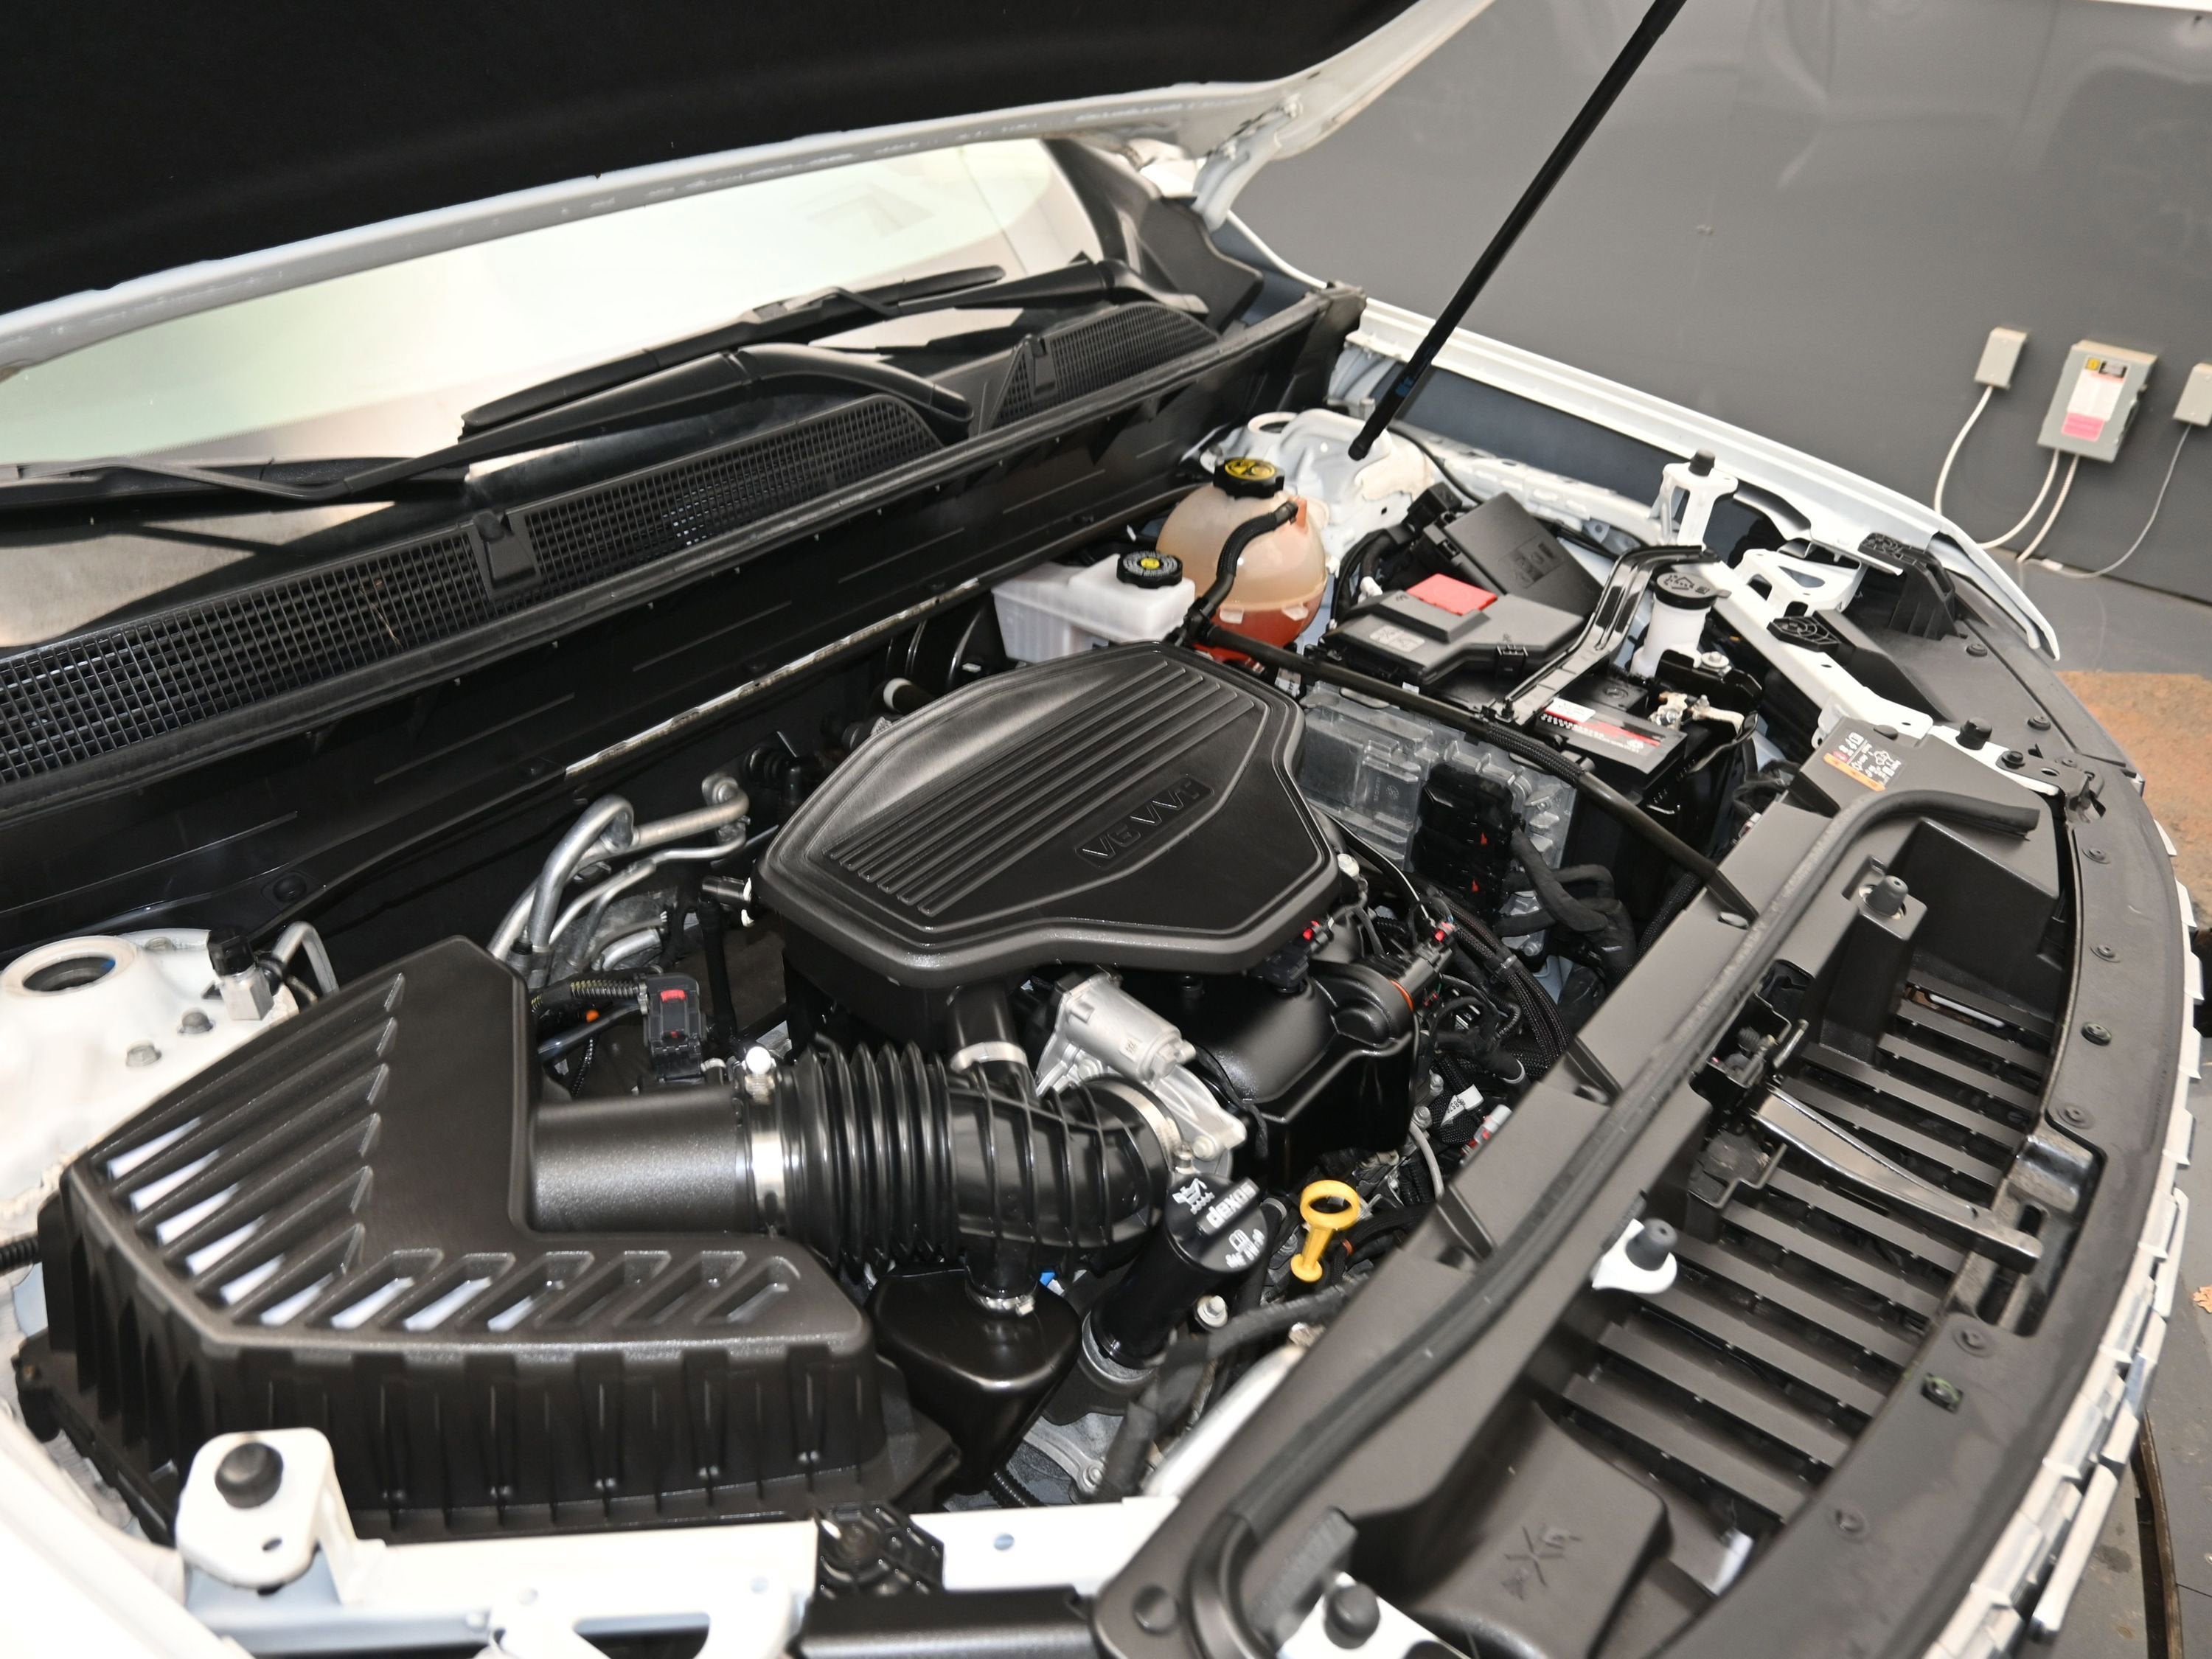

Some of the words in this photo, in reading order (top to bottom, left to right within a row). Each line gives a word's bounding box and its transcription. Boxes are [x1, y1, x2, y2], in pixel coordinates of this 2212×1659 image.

[1082, 824, 1141, 859] V6
[1130, 779, 1200, 826] VVT
[1206, 1182, 1256, 1228] dexos
